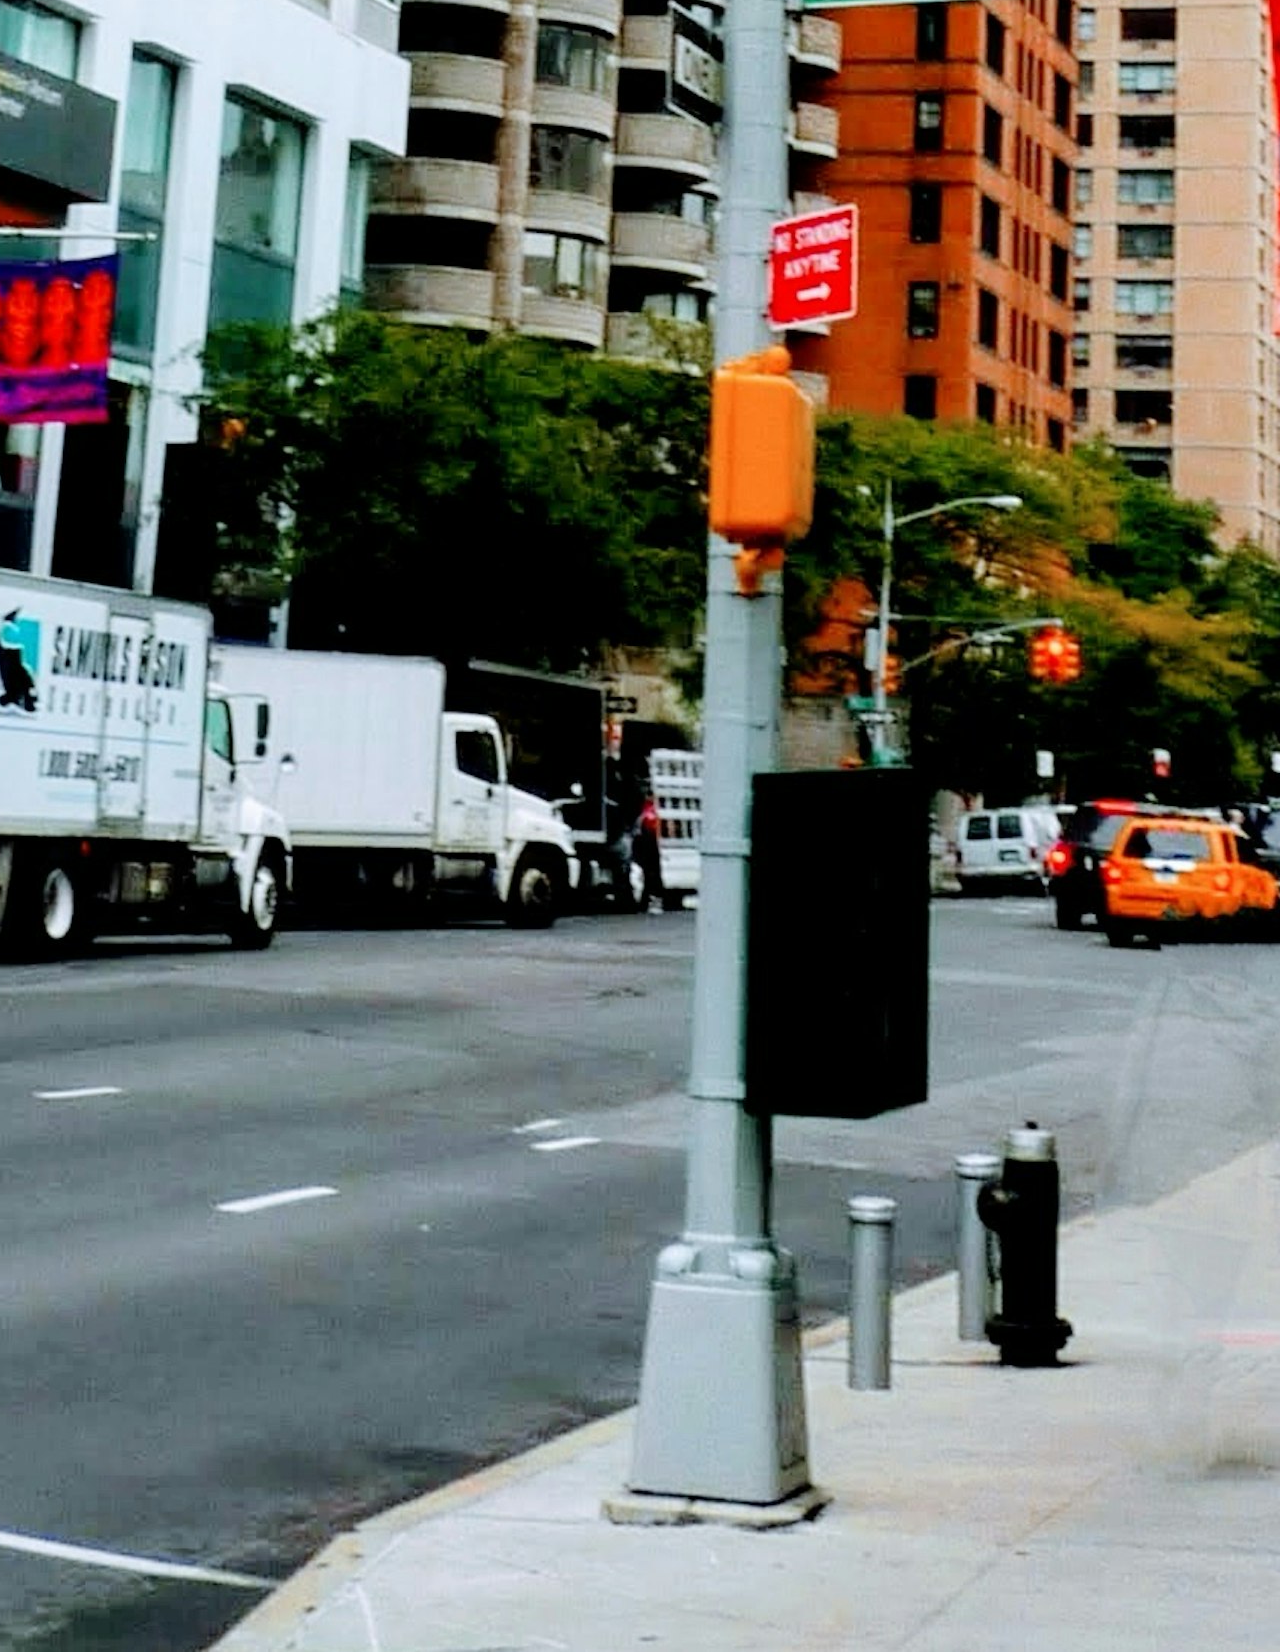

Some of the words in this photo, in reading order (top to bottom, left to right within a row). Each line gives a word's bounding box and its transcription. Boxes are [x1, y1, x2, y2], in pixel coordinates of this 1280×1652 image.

[775, 231, 792, 253] NO
[794, 218, 851, 250] STANDING
[783, 249, 842, 280] ANYTIME
[52, 626, 129, 683] SAMUELS
[153, 640, 187, 692] SON
